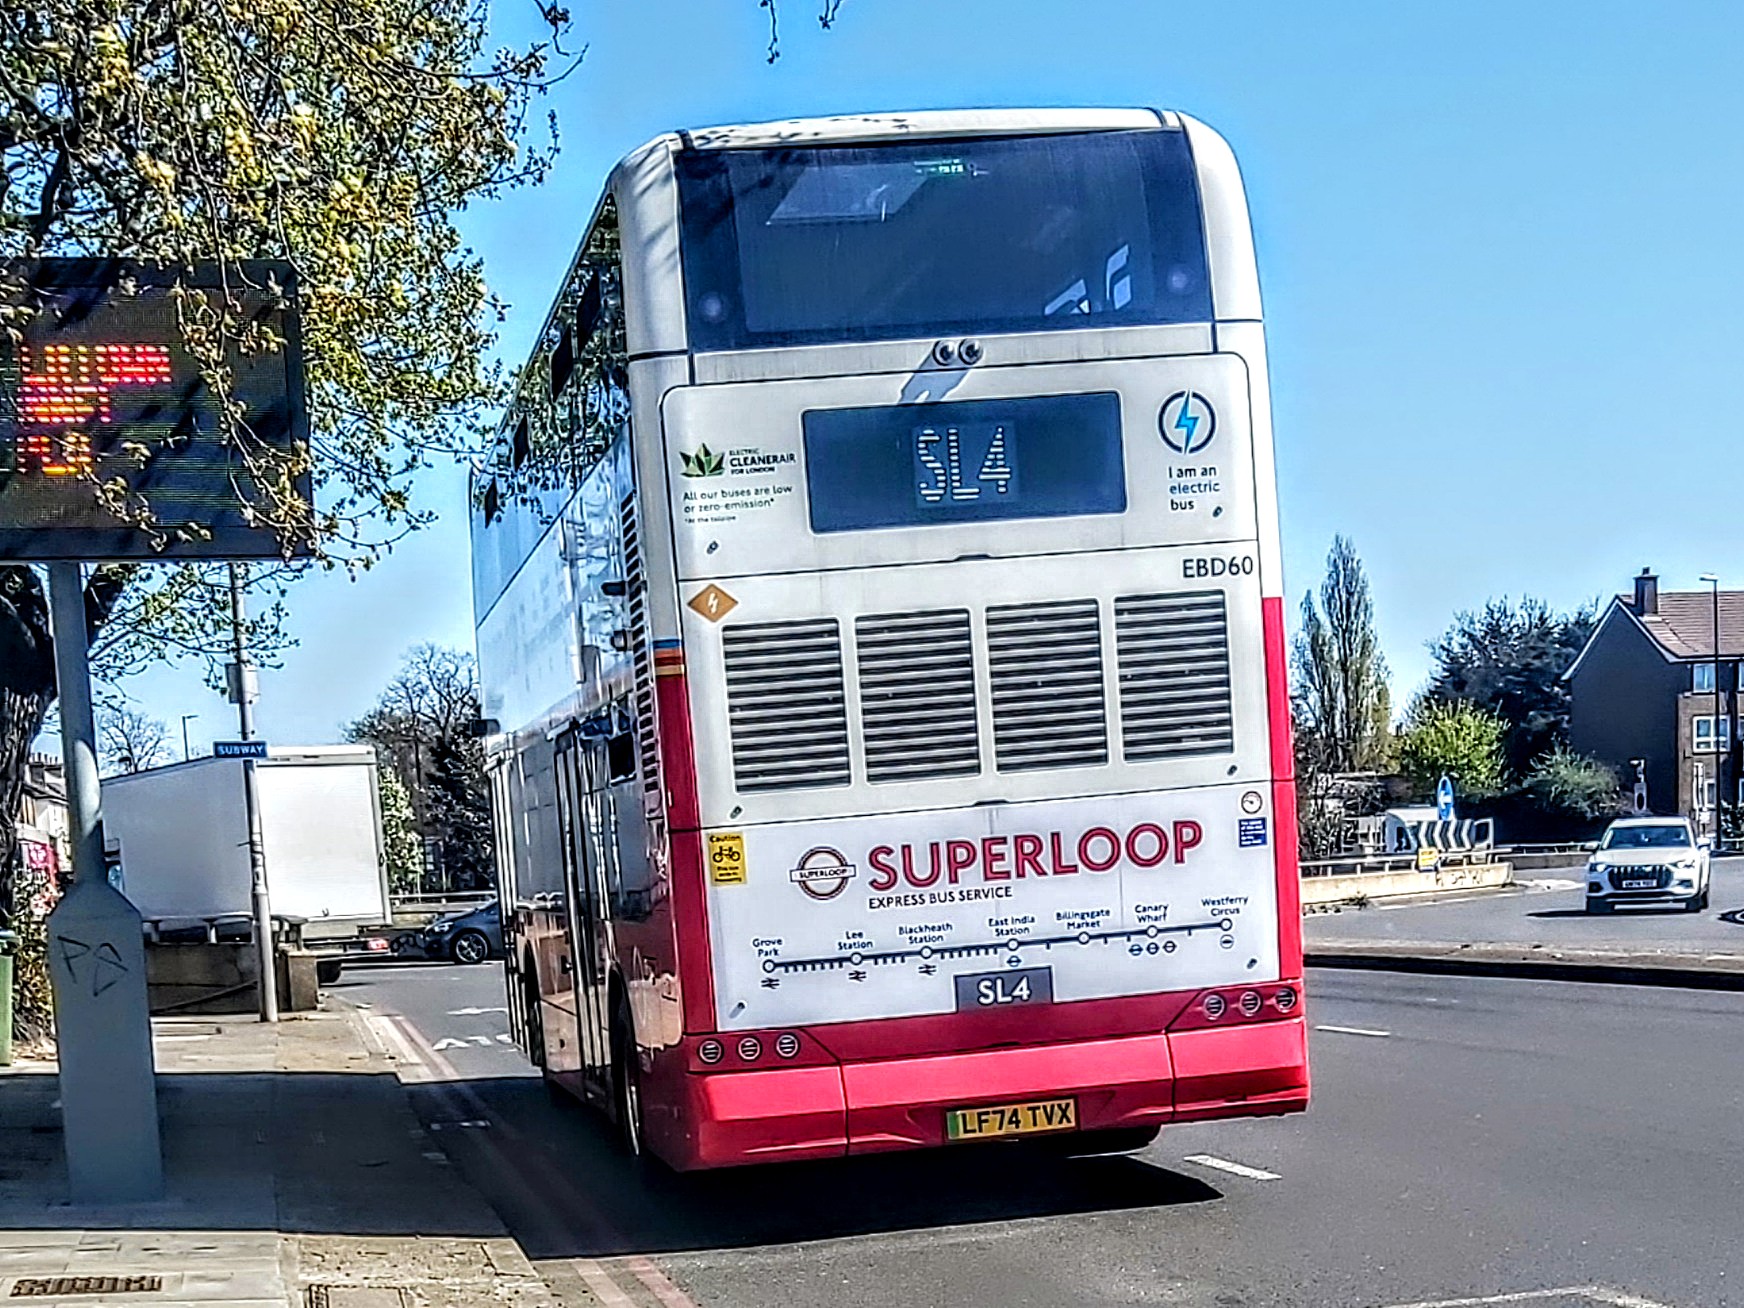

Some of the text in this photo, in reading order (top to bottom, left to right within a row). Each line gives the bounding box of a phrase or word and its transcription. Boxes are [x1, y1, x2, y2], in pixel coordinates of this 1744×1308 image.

[917, 427, 1011, 501] SL4
[731, 466, 775, 475] FOR LONDON
[1168, 466, 1217, 479] I am an
[683, 485, 793, 501] All our buses are low
[1169, 481, 1221, 495] electric
[683, 505, 696, 513] or
[1170, 499, 1195, 511] bus
[1182, 556, 1254, 579] EBD60
[217, 745, 263, 754] SUBWAY
[868, 819, 1203, 891] SUPERLOOP
[799, 868, 848, 879] SUPERLOOP
[869, 886, 1013, 909] EXPRESS BUS SERVICE
[1201, 896, 1249, 907] Westferry
[1134, 903, 1169, 915] Canary
[1210, 906, 1241, 917] Circus
[1056, 908, 1110, 922] Billingsgate
[1137, 912, 1167, 923] Wharf
[988, 915, 1036, 927] East India
[1067, 920, 1100, 931] Market
[898, 922, 953, 936] Blackheath
[994, 926, 1030, 937] Station
[845, 930, 864, 940] Lee
[909, 933, 944, 944] Station
[752, 938, 783, 948] Grove
[838, 940, 873, 950] Station
[758, 946, 779, 957] Park
[977, 976, 1031, 1005] SL4
[961, 1103, 1072, 1134] LF74 TVX
